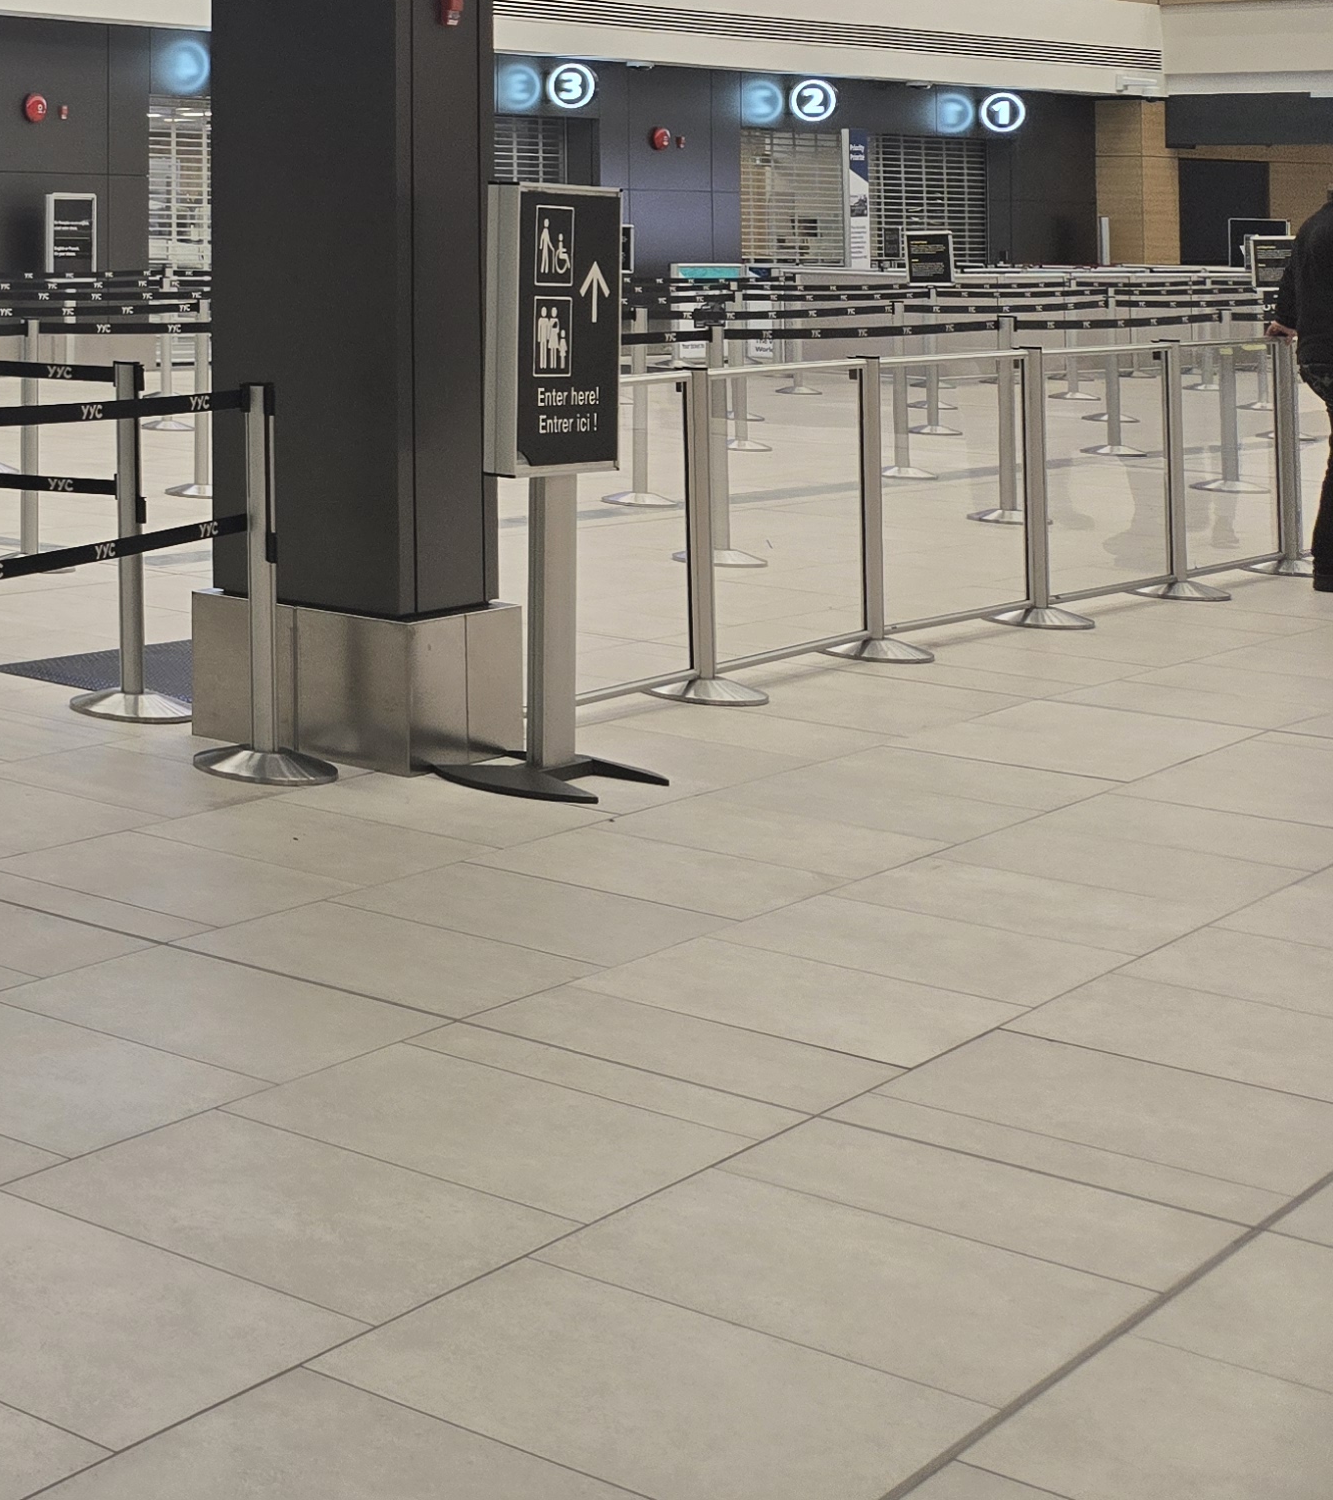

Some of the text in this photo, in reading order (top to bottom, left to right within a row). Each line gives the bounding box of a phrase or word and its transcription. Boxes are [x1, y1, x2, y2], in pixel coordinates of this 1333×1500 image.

[559, 72, 582, 100] 3
[802, 88, 824, 113] 2
[992, 101, 1009, 124] 1
[47, 365, 72, 379] YYC
[81, 404, 103, 420] YYC
[189, 395, 210, 411] YYC
[537, 386, 599, 407] Enter here!
[539, 415, 573, 434] Entrer
[576, 415, 591, 431] ici
[47, 478, 74, 491] YYC
[94, 542, 116, 560] YYC
[199, 521, 219, 538] YYC
